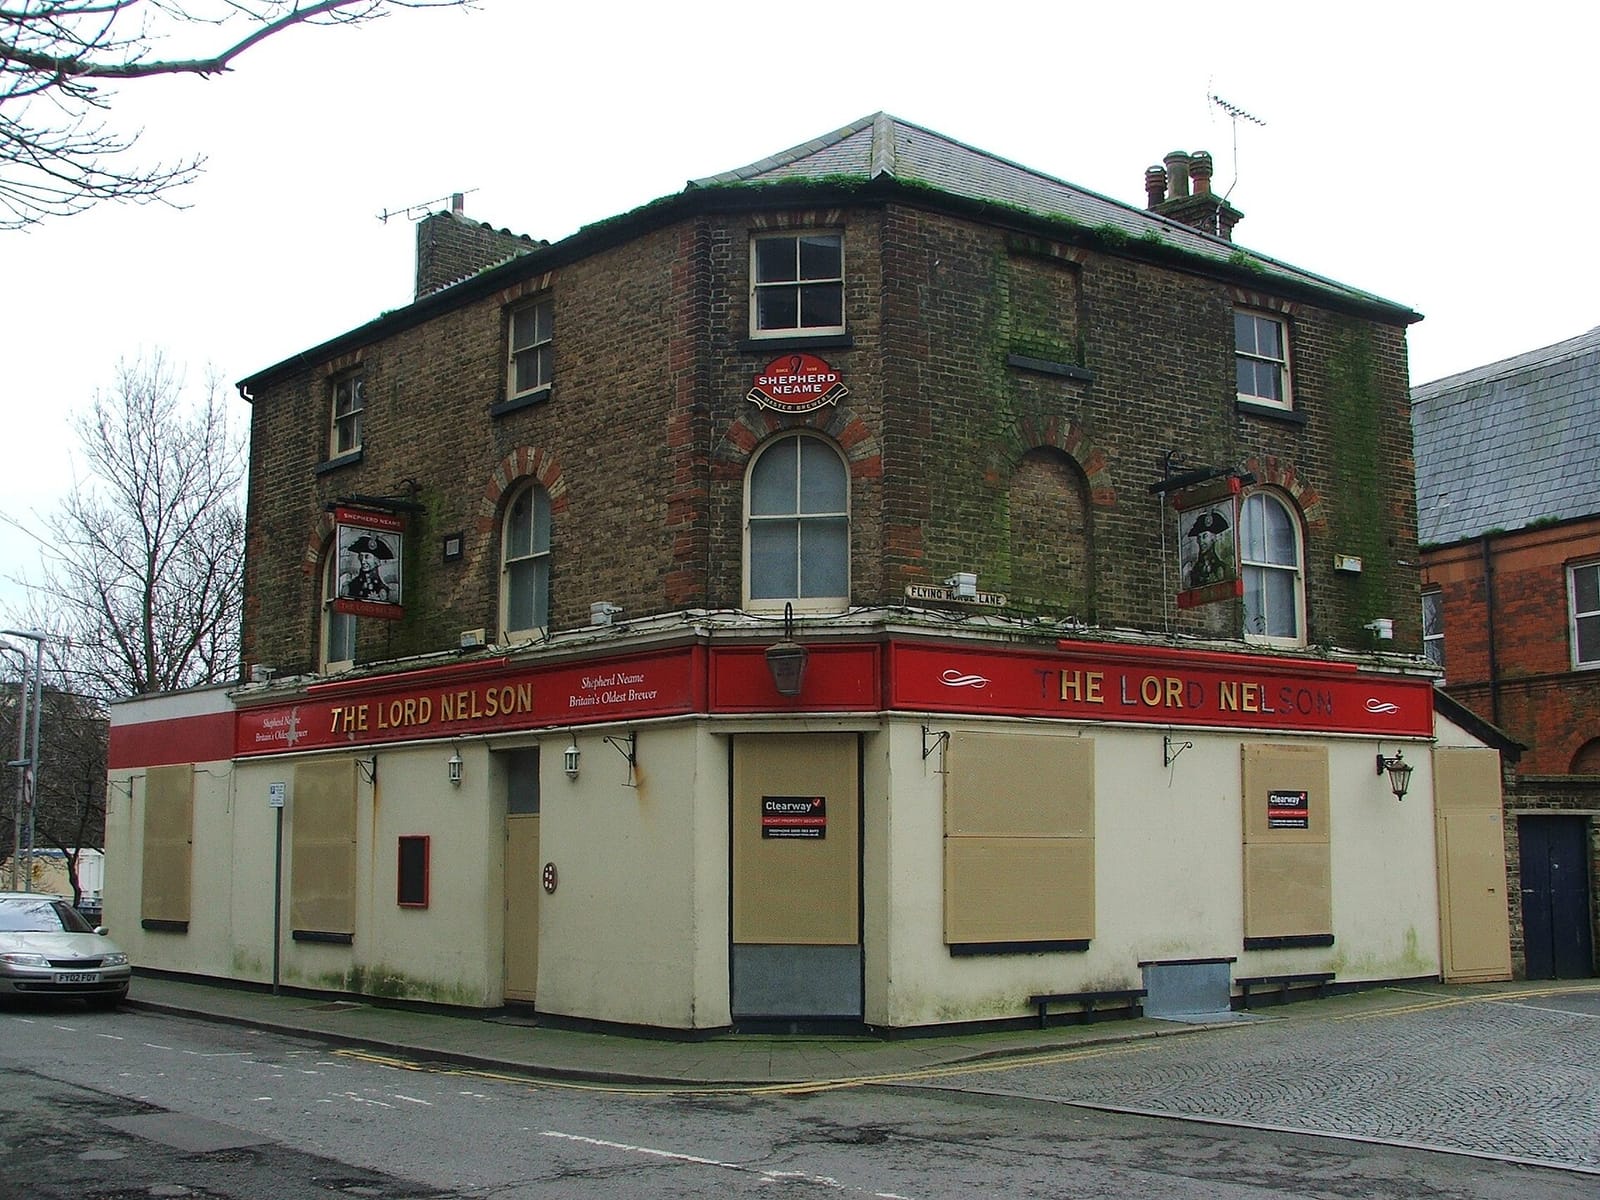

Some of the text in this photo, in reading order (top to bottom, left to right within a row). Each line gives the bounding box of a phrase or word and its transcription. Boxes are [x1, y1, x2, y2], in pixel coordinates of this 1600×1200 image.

[759, 373, 836, 385] SHEPHERD
[772, 384, 822, 394] NEAME
[911, 587, 943, 599] FLYING
[978, 593, 1002, 605] LANE
[581, 672, 645, 690] Shepherd Neame
[569, 688, 658, 707] Britain's Oldest Brewer
[1032, 668, 1334, 717] THE LORD NELSON
[330, 682, 533, 733] THE LORD NELSON
[765, 801, 812, 813] Clearway
